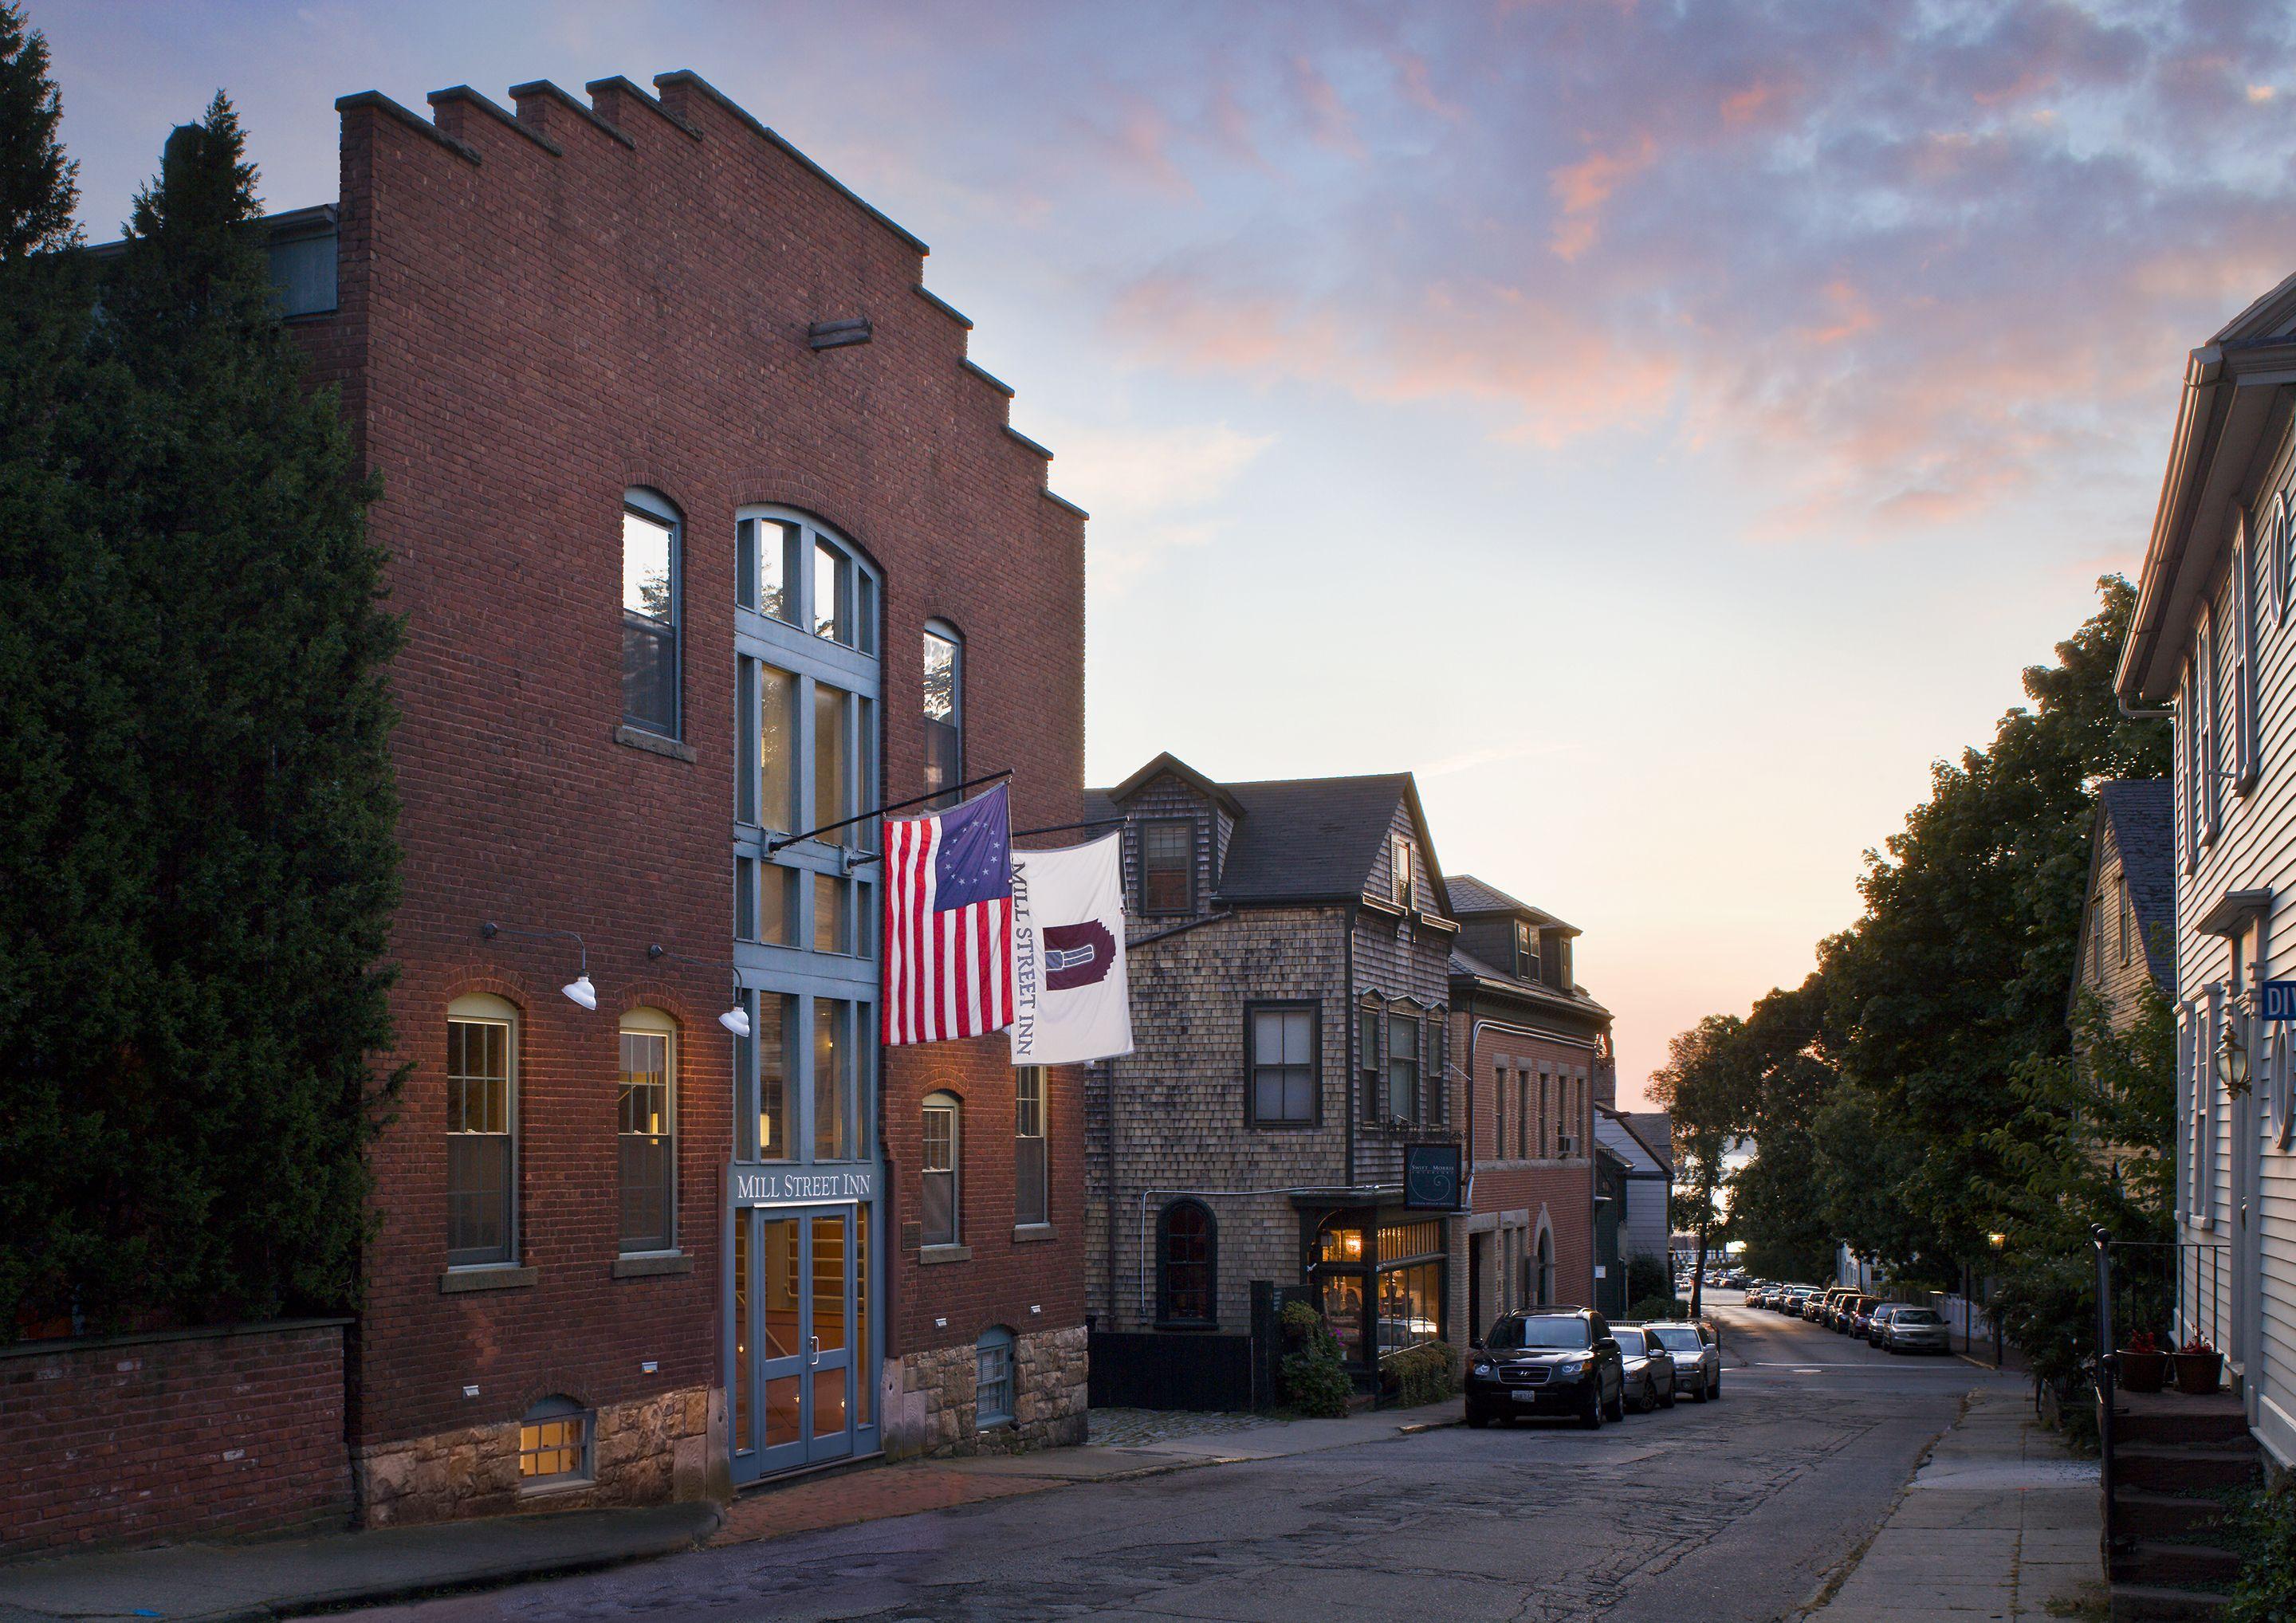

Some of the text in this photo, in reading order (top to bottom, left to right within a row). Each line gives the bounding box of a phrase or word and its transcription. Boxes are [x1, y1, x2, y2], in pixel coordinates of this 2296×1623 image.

[1012, 861, 1036, 1055] MILL STREET INN
[737, 1173, 871, 1198] MILL STREET INN
